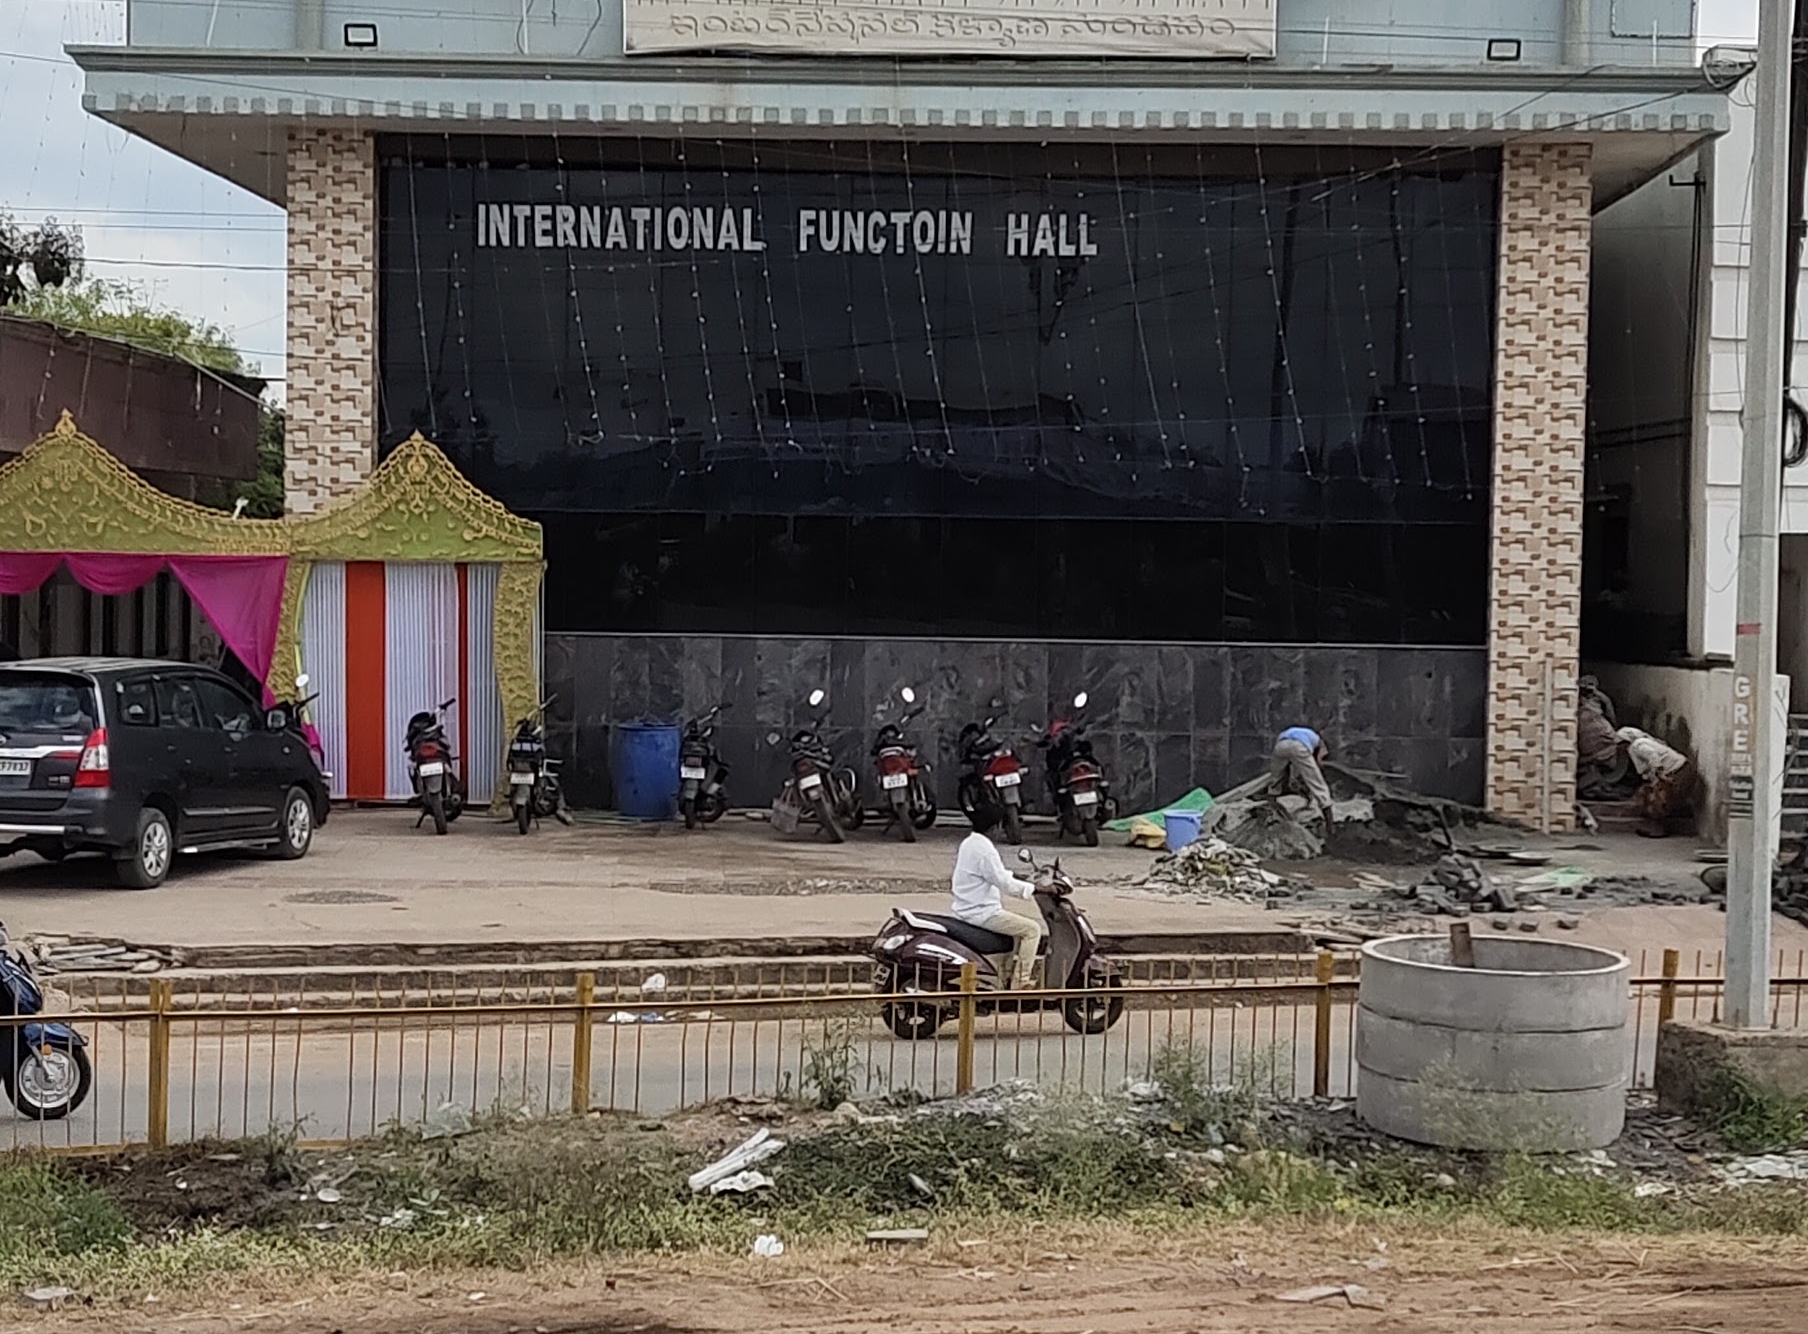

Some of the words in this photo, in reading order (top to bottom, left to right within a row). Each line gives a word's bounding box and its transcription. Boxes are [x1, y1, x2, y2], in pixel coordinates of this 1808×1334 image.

[476, 203, 766, 253] INTERNATIONAL
[797, 208, 974, 256] FUNCTOIN
[1006, 211, 1099, 258] HALL
